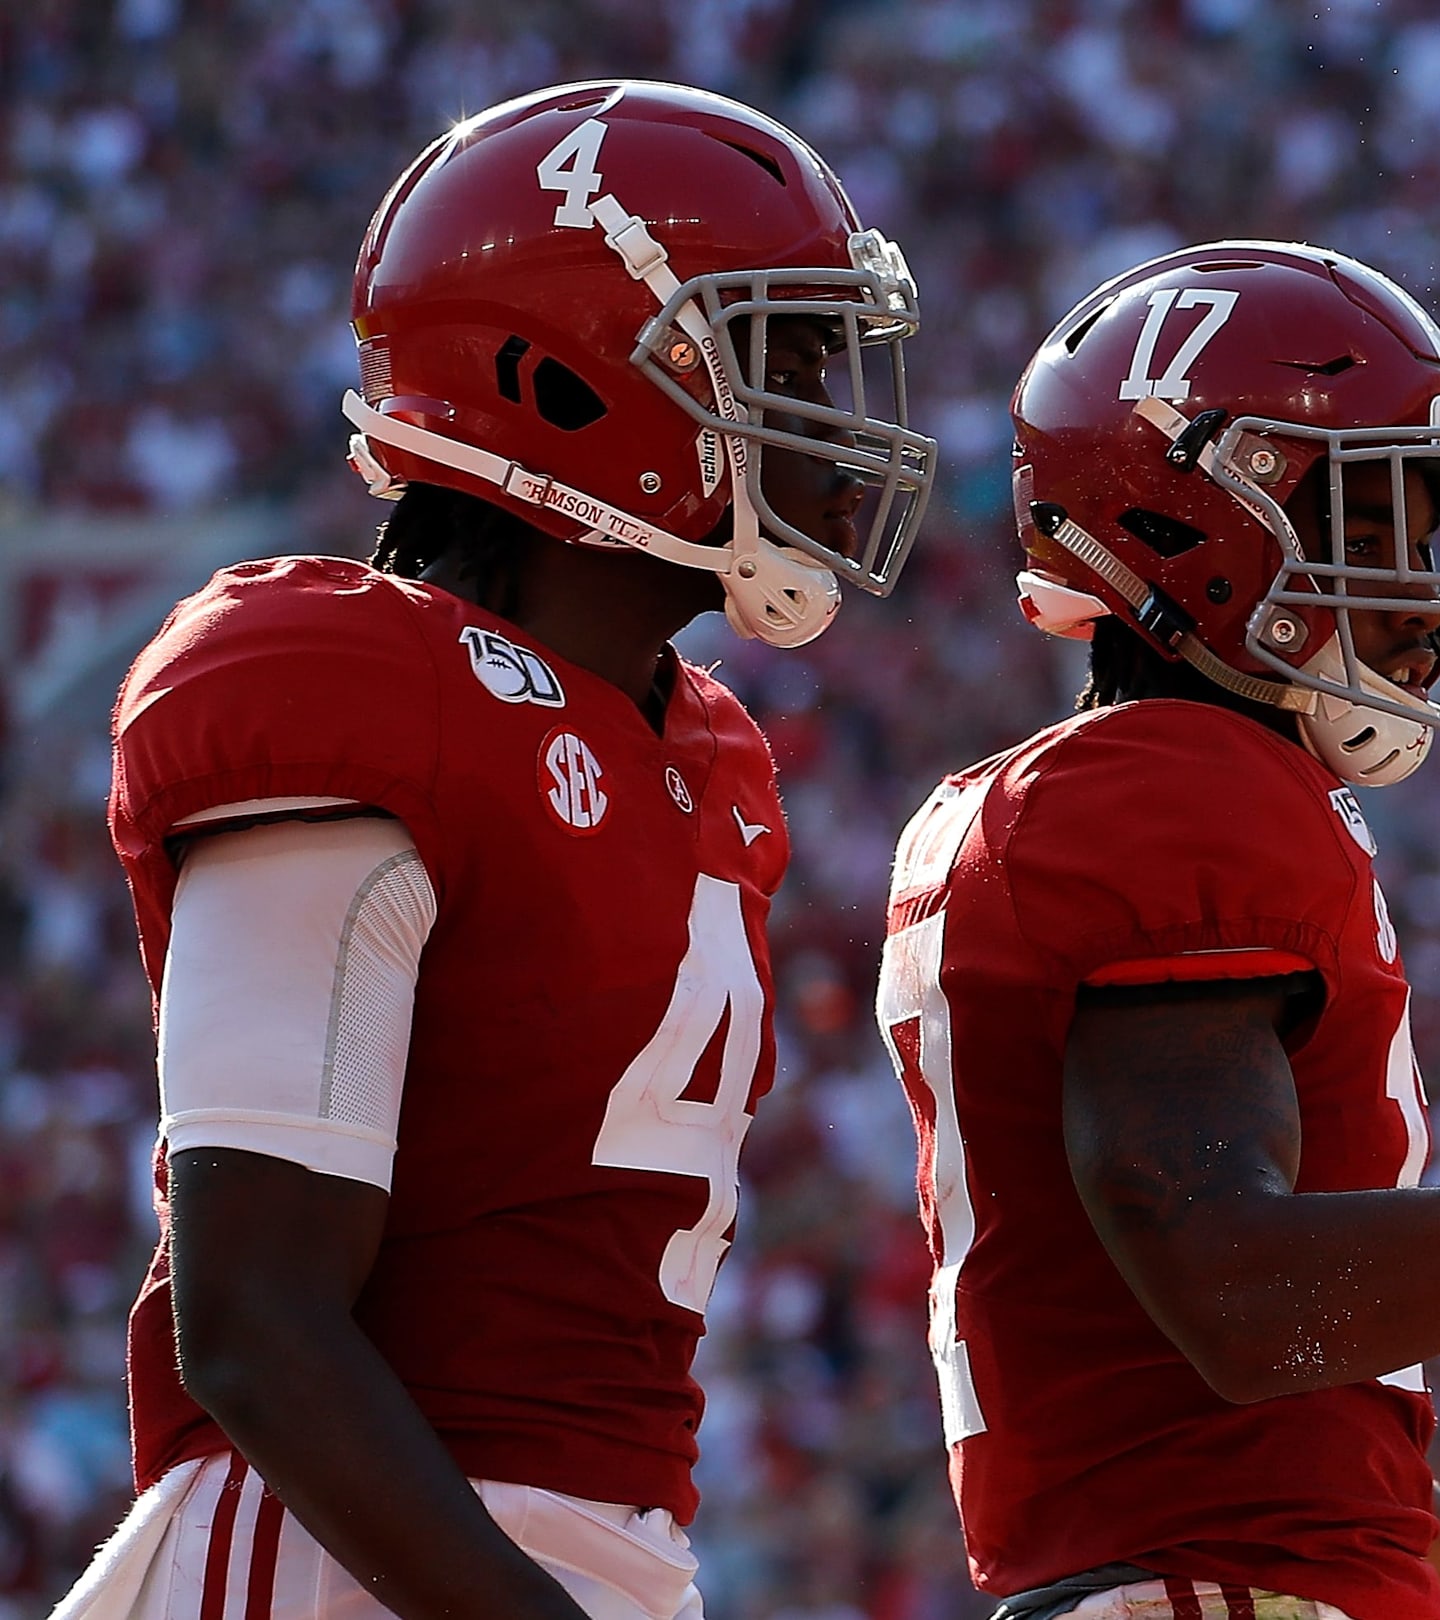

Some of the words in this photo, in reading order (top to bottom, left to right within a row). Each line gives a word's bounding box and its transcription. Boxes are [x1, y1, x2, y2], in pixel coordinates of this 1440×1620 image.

[536, 117, 609, 228] 4
[702, 336, 739, 423] CRIMSON
[1119, 288, 1239, 401] 17
[522, 479, 605, 524] CRMSON
[700, 431, 716, 484] schutt
[459, 625, 566, 708] 150
[546, 732, 609, 828] SEC
[591, 871, 766, 1315] 4
